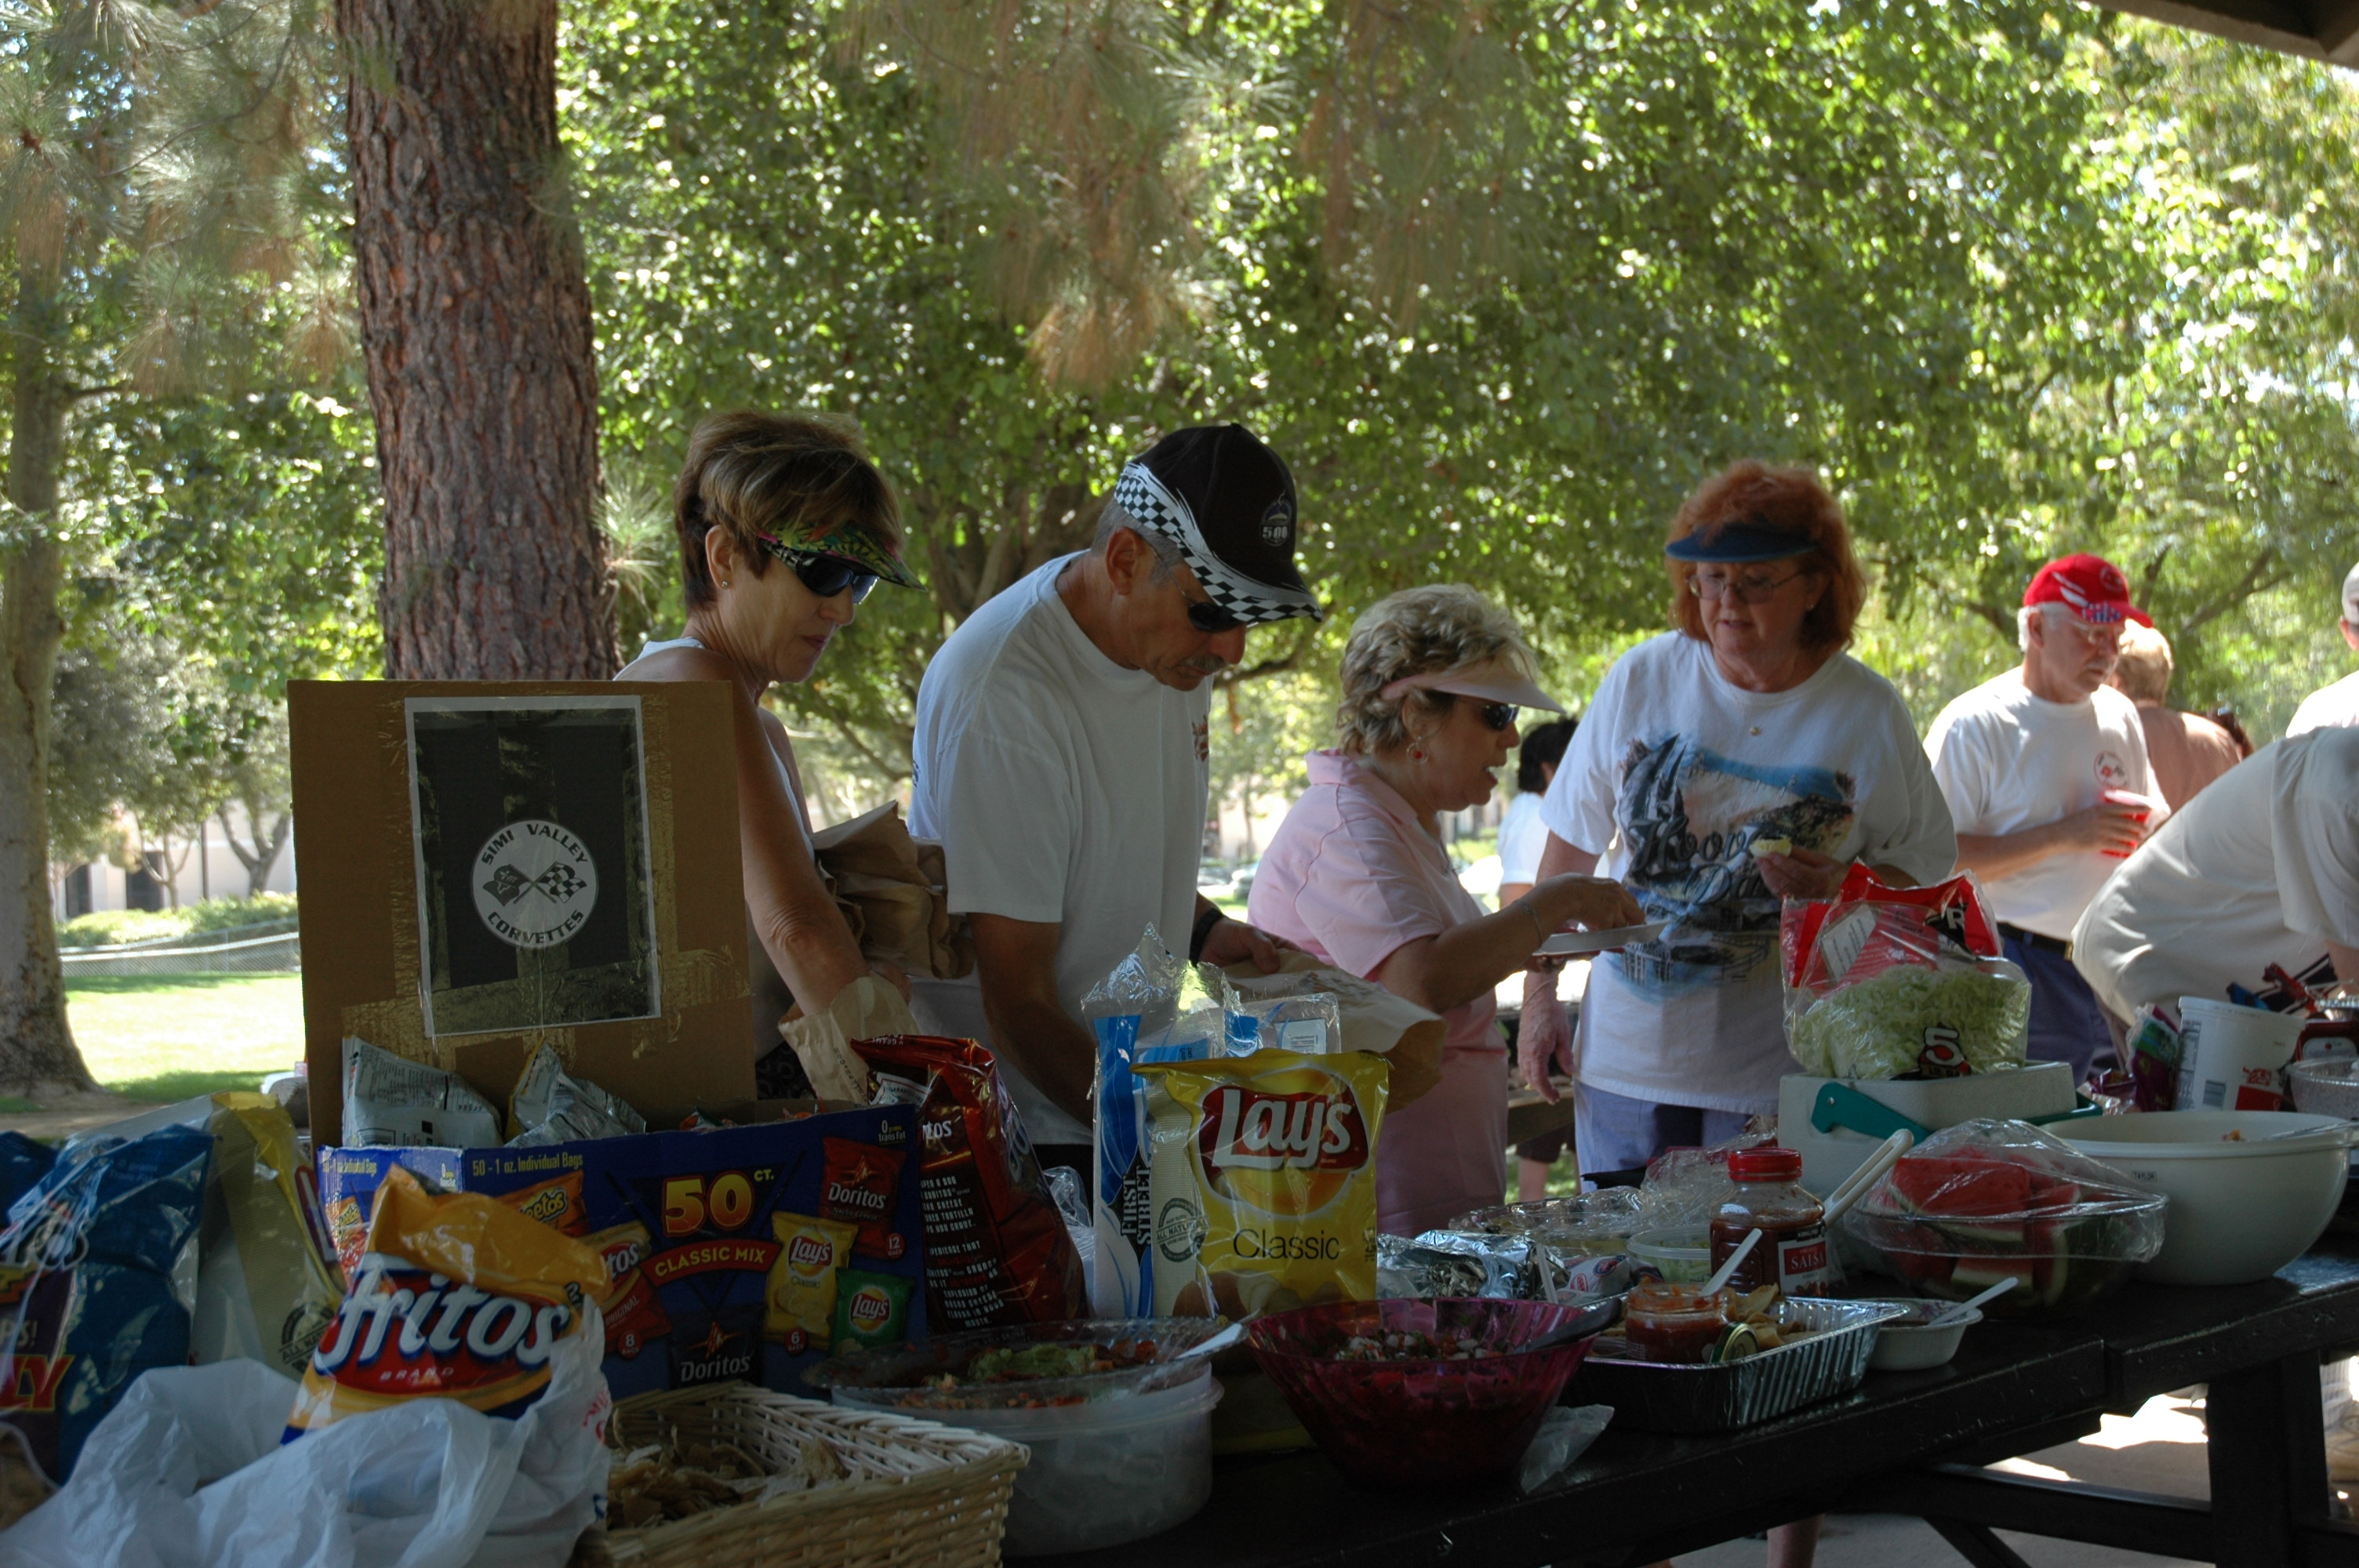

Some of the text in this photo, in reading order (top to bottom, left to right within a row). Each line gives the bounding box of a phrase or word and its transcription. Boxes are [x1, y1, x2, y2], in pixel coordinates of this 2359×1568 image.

[1262, 526, 1288, 539] 500
[481, 823, 587, 865] SIMI VALLEY
[1629, 815, 1761, 873] Hoov
[488, 909, 583, 944] CORVETTES
[1925, 1028, 1964, 1066] 5
[878, 1133, 896, 1142] Trans
[881, 1119, 889, 1134] 0
[472, 1160, 485, 1176] 50
[496, 1158, 500, 1174] 1
[503, 1161, 516, 1174] oz.
[518, 1153, 560, 1172] Individual
[562, 1152, 583, 1170] Bags
[523, 1189, 565, 1220] eetos
[663, 1168, 775, 1236] 50 CT.
[827, 1181, 886, 1210] Doritos
[1122, 1174, 1137, 1236] FIRST
[1137, 1166, 1151, 1246] STREET
[889, 1236, 900, 1250] 12
[1157, 1232, 1167, 1240] ALL
[1169, 1219, 1209, 1236] NATUAL
[1233, 1229, 1339, 1261] Classic
[607, 1243, 641, 1279] tos
[655, 1246, 766, 1277] CLASSIC MIX
[1791, 1251, 1825, 1270] SALSA
[791, 1276, 820, 1289] Classic
[605, 1295, 640, 1325] ORIGINAL
[625, 1333, 636, 1347] 8
[791, 1331, 801, 1345] 6
[680, 1354, 751, 1383] Doritos
